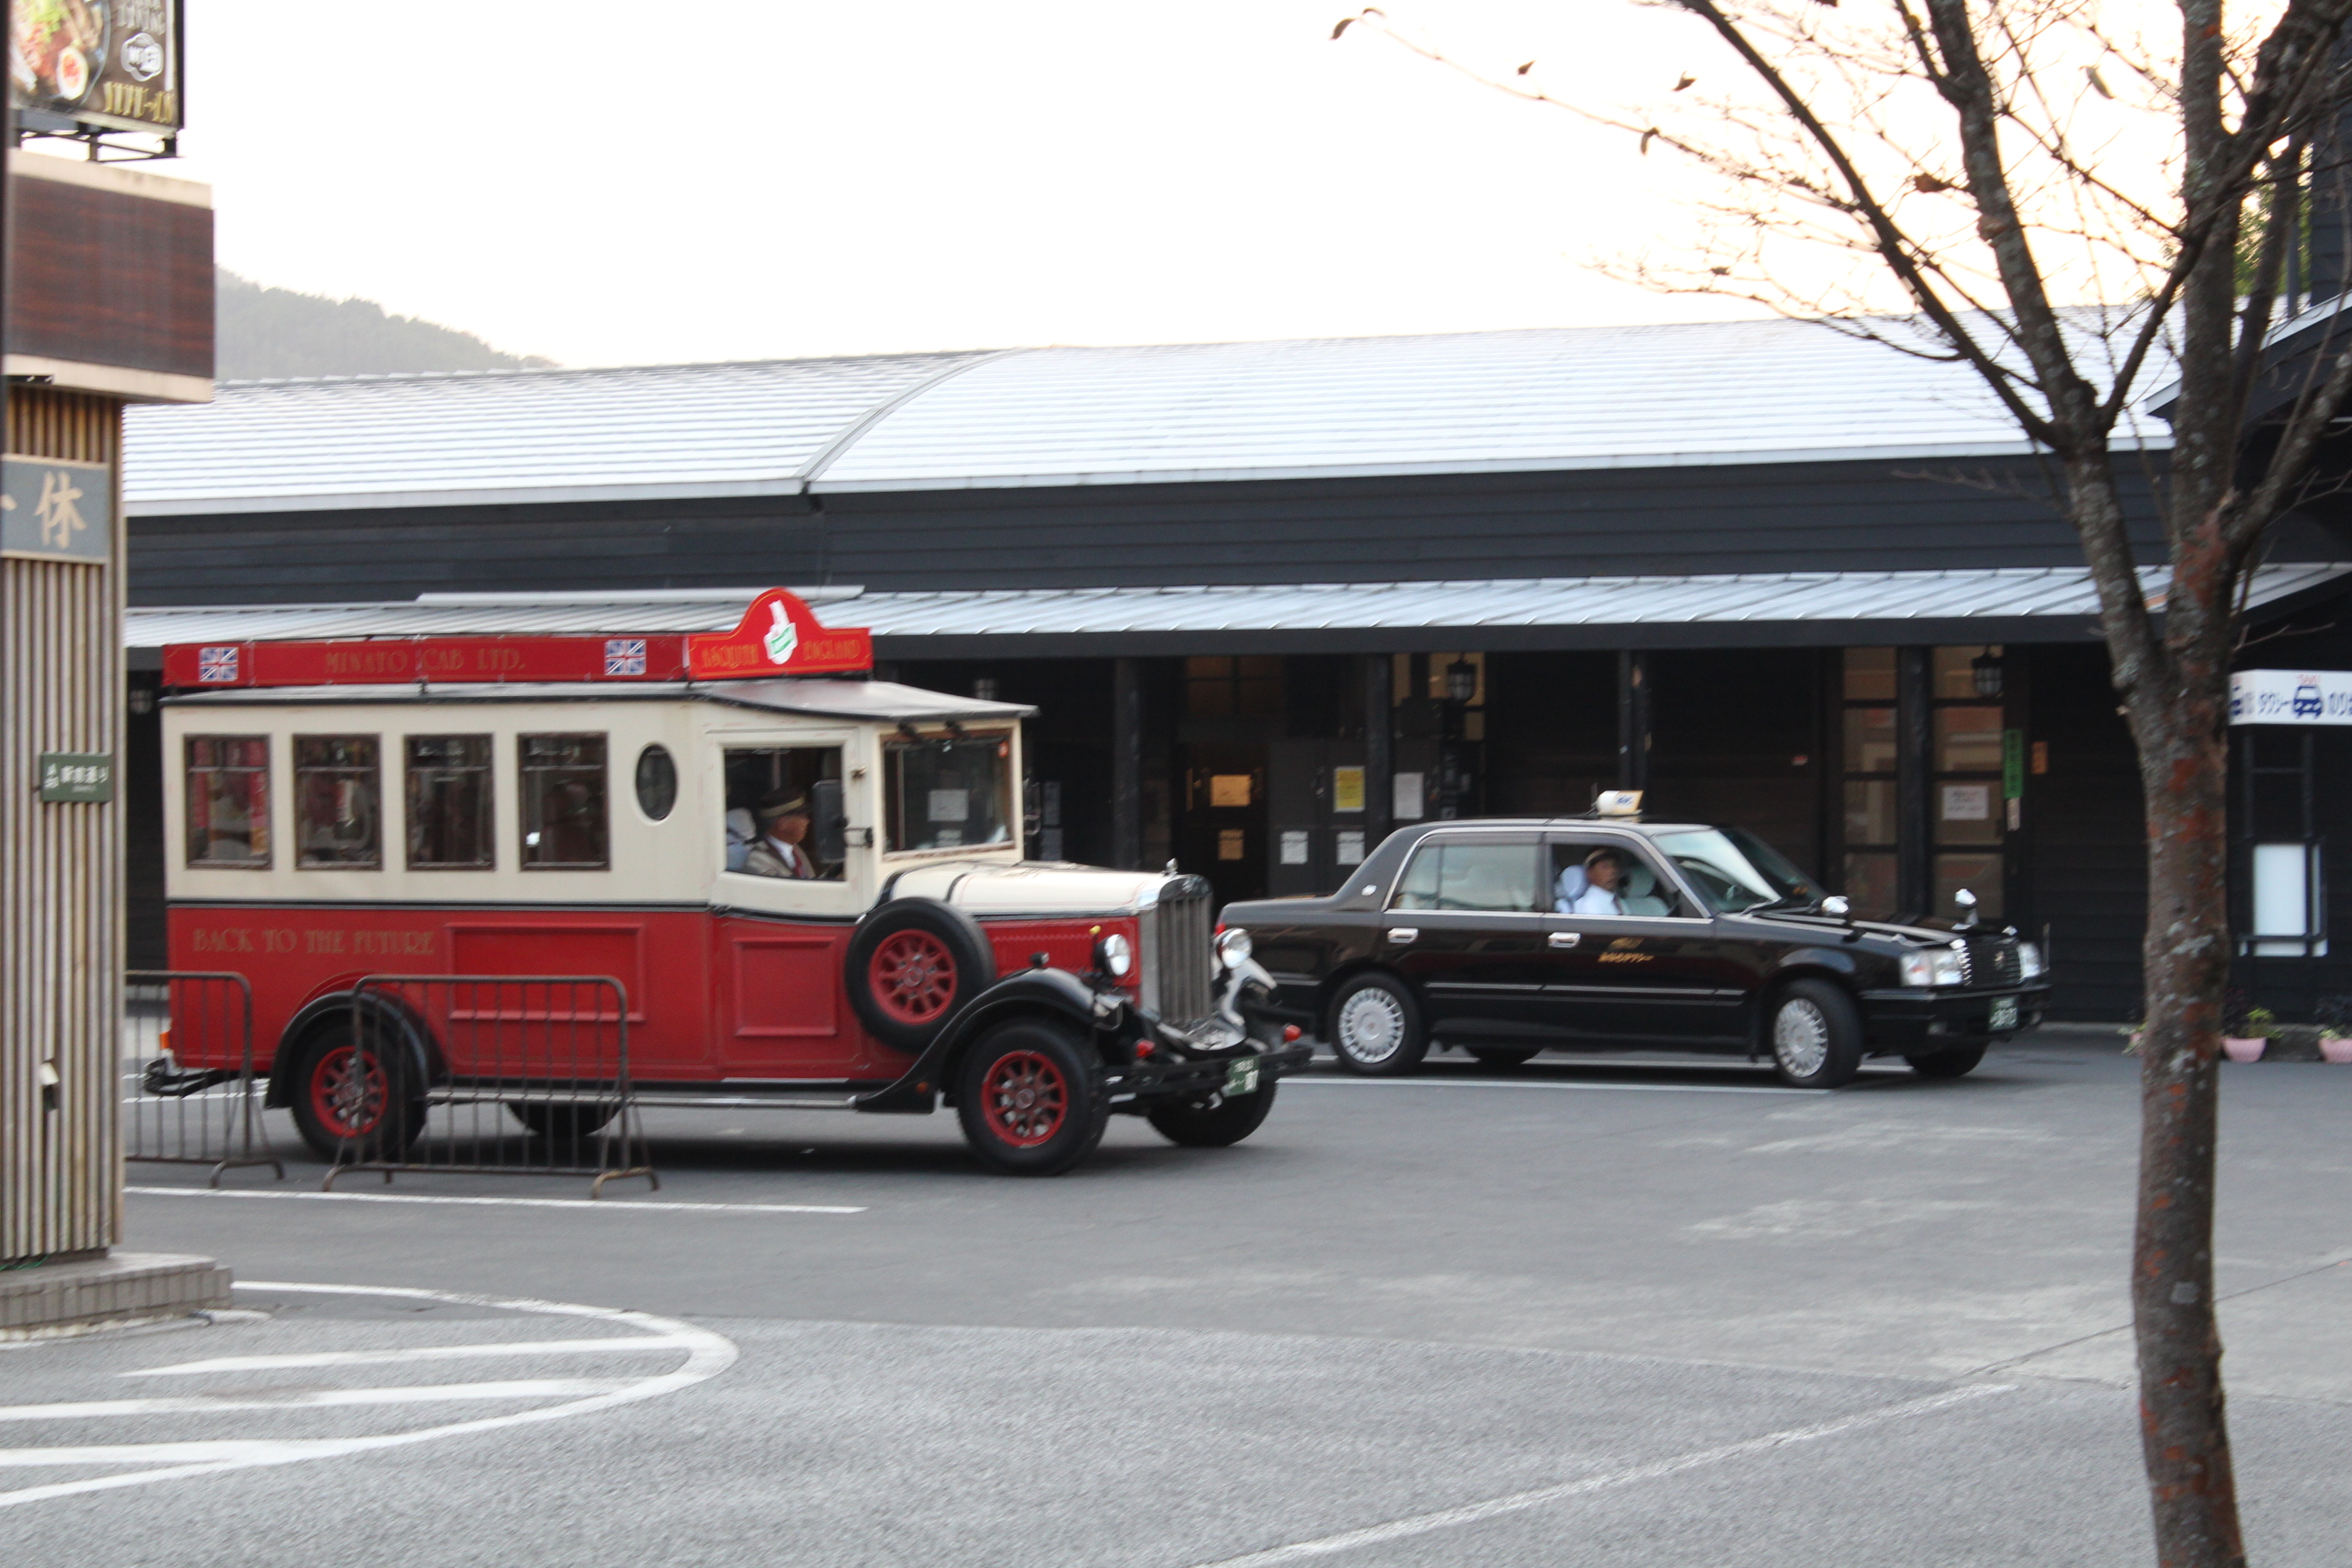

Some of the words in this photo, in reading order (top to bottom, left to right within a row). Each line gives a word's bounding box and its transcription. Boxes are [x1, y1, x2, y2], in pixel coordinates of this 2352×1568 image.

[324, 649, 408, 674] MINATO
[422, 647, 466, 671] CAB
[476, 647, 526, 671] LTD.
[192, 927, 255, 953] BACK
[262, 927, 298, 953] TO
[303, 928, 346, 954] THE
[353, 929, 436, 955] FUTURE
